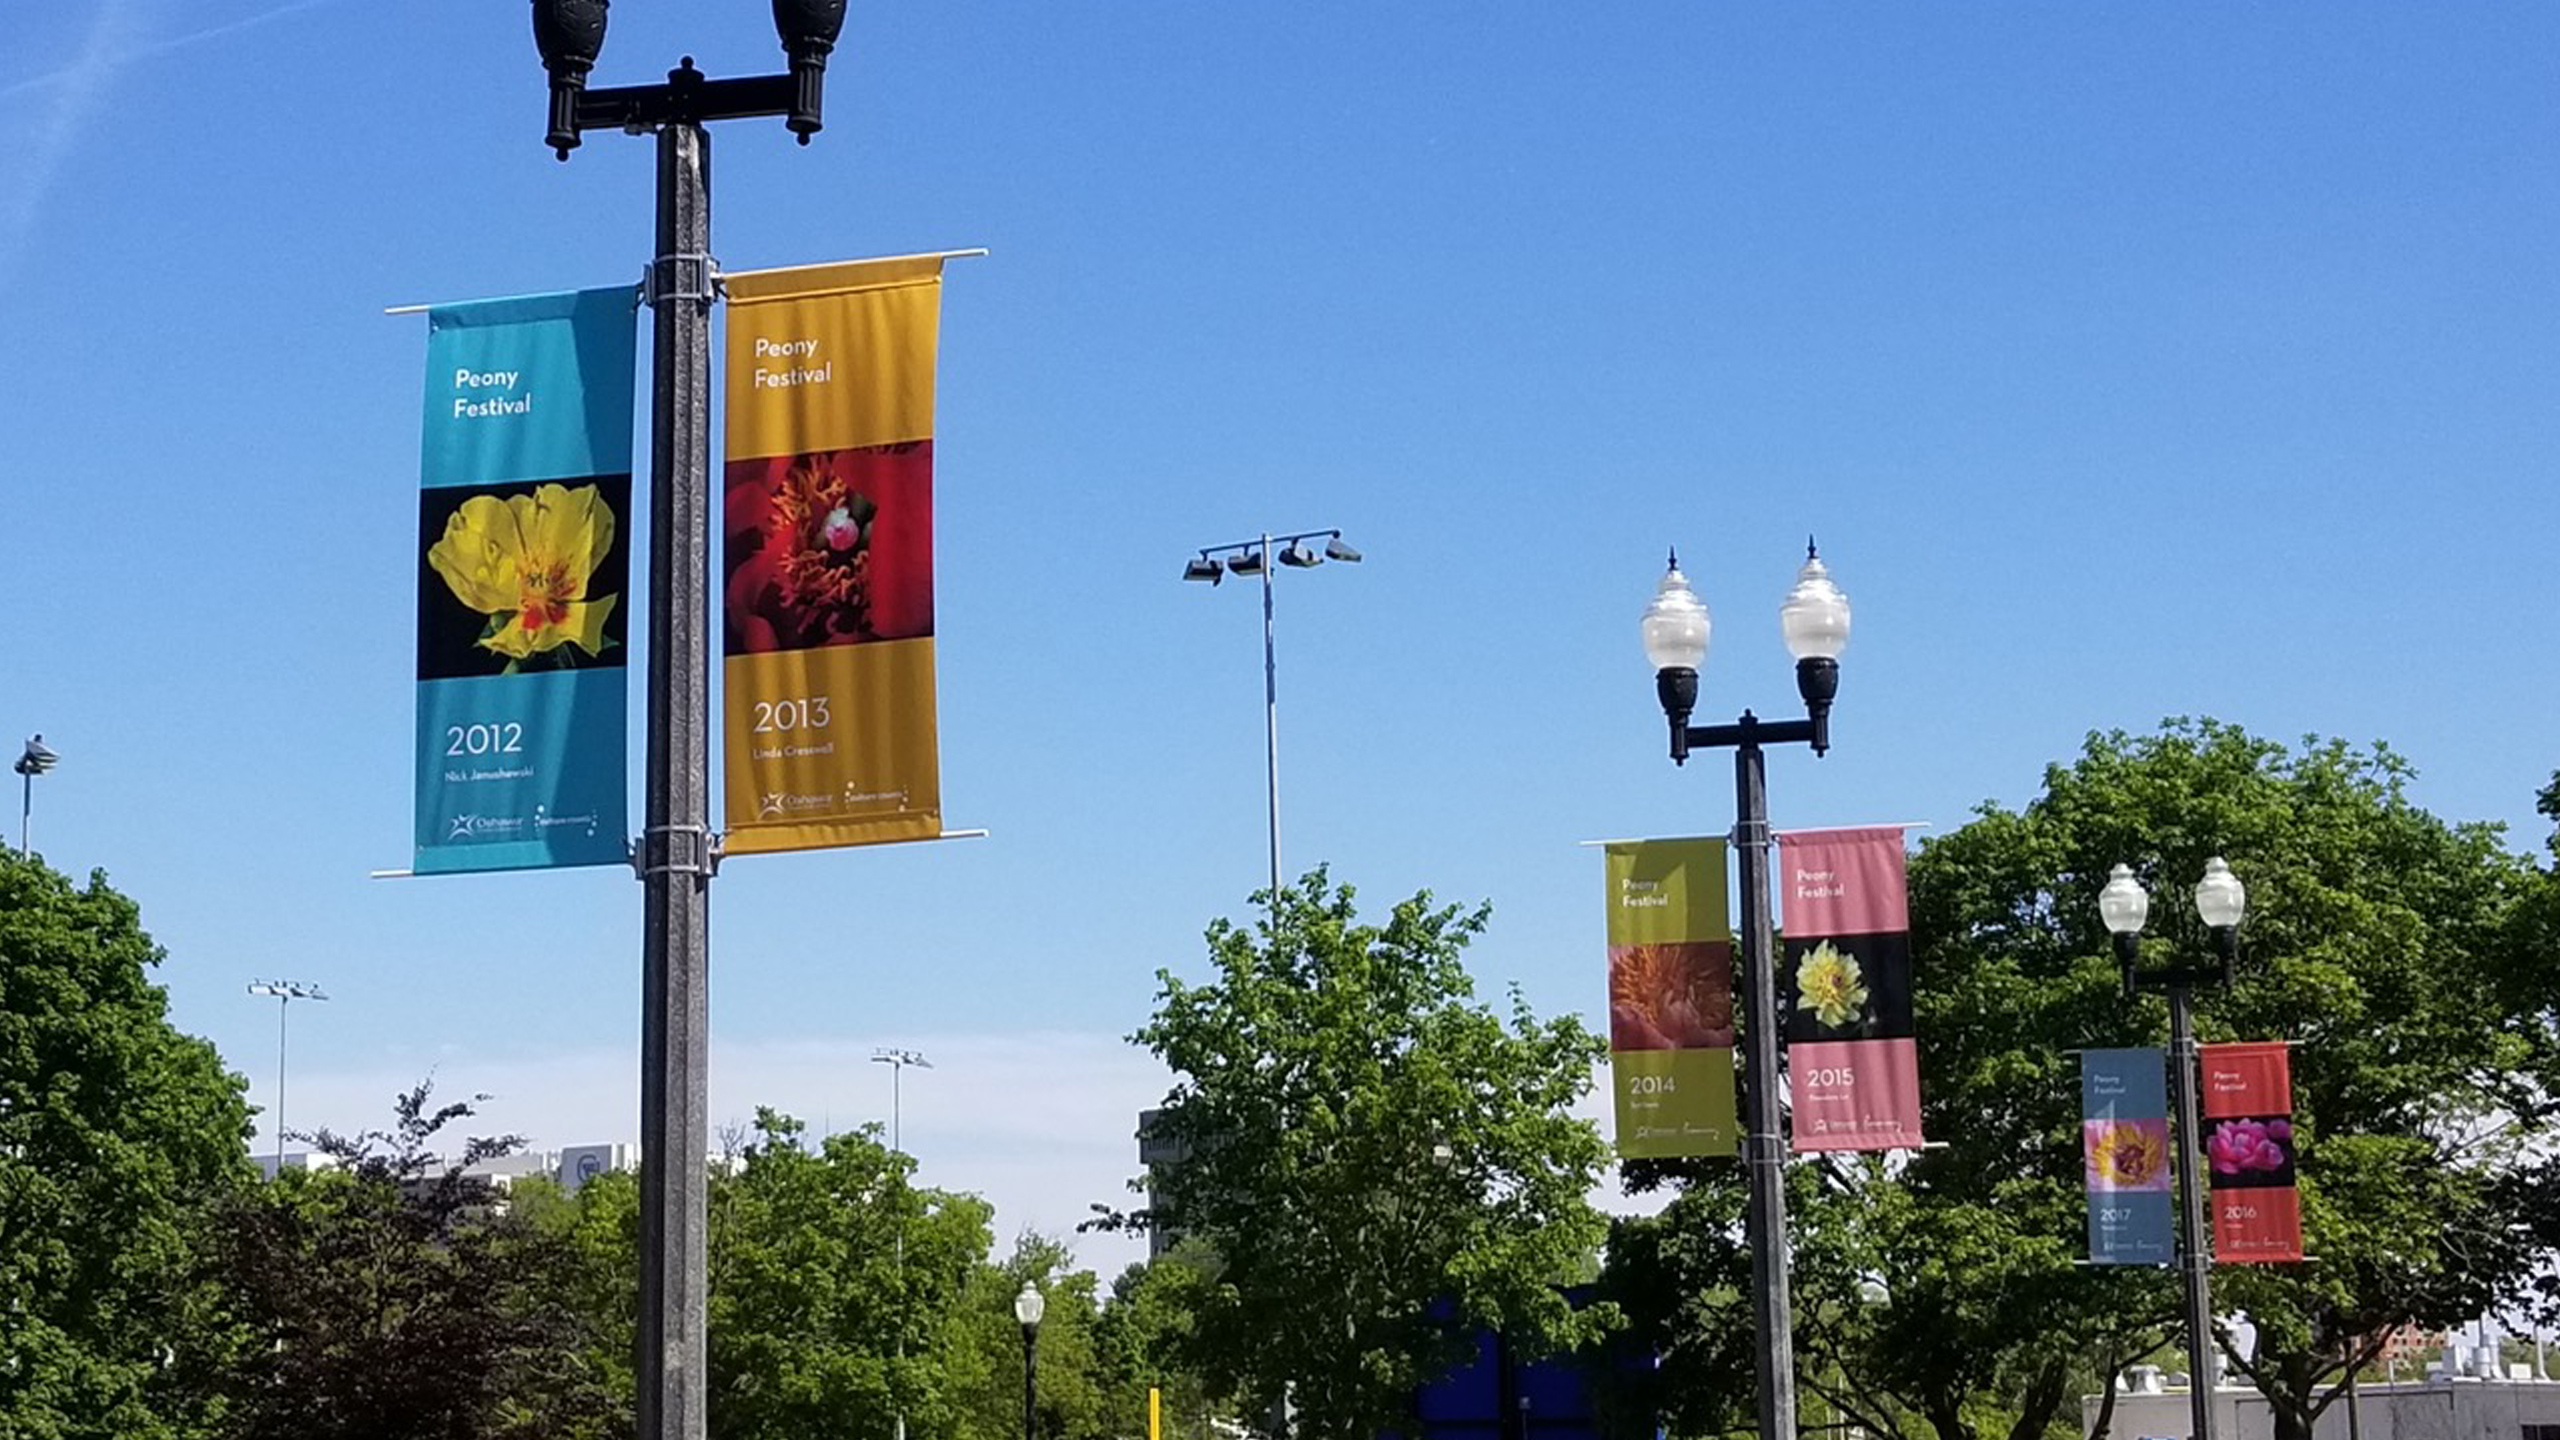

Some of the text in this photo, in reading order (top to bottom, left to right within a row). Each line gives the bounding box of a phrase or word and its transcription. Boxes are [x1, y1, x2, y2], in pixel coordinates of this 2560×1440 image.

[755, 338, 818, 358] Peony
[455, 368, 519, 390] Peony
[754, 361, 832, 389] Festival
[454, 392, 531, 419] Festival
[753, 697, 830, 733] 2013
[446, 722, 523, 756] 2012
[1622, 878, 1658, 892] Peony
[1797, 869, 1835, 882] Peony
[1797, 882, 1845, 899] Festival
[1622, 893, 1669, 908] Festival
[1630, 1076, 1676, 1095] 2014
[1807, 1067, 1855, 1088] 2015
[2100, 1208, 2131, 1222] 2017
[2224, 1206, 2257, 1220] 2016
